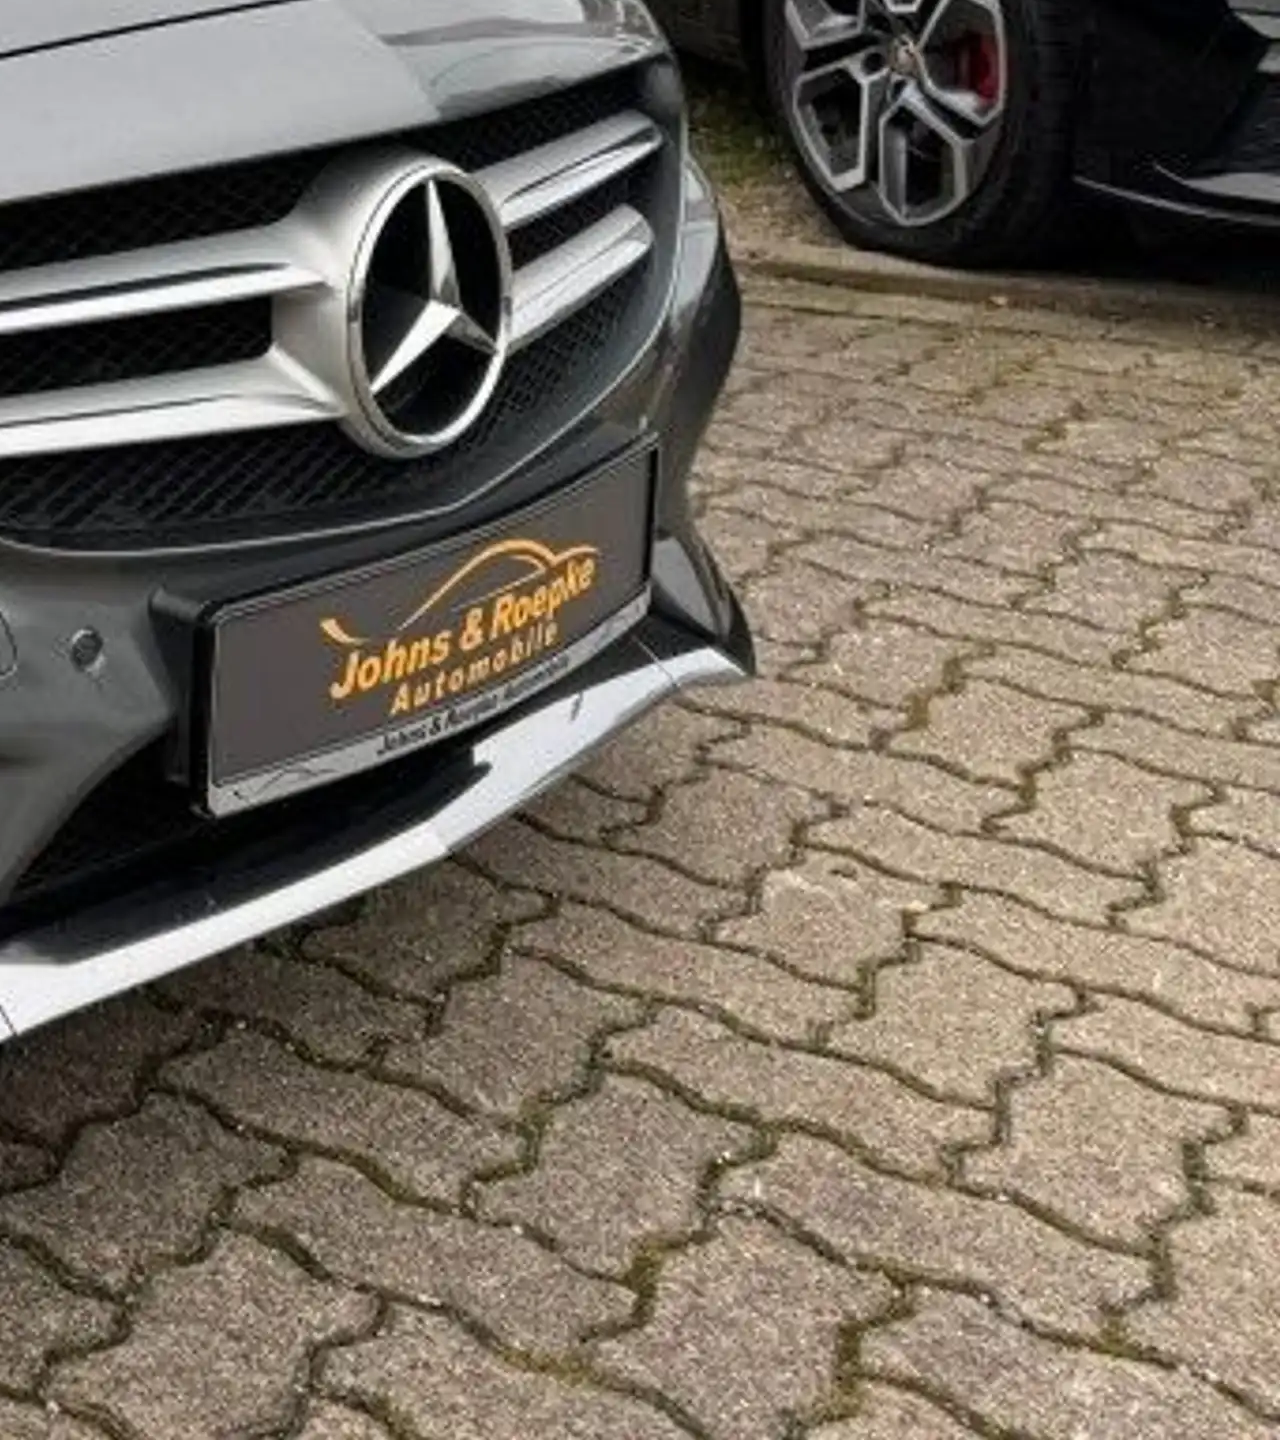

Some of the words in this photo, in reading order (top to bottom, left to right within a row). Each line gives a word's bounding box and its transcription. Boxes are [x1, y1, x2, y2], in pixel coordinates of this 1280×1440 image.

[328, 628, 453, 700] Johns
[458, 606, 486, 653] &
[488, 558, 597, 642] Roepke
[389, 620, 560, 716] Automobile
